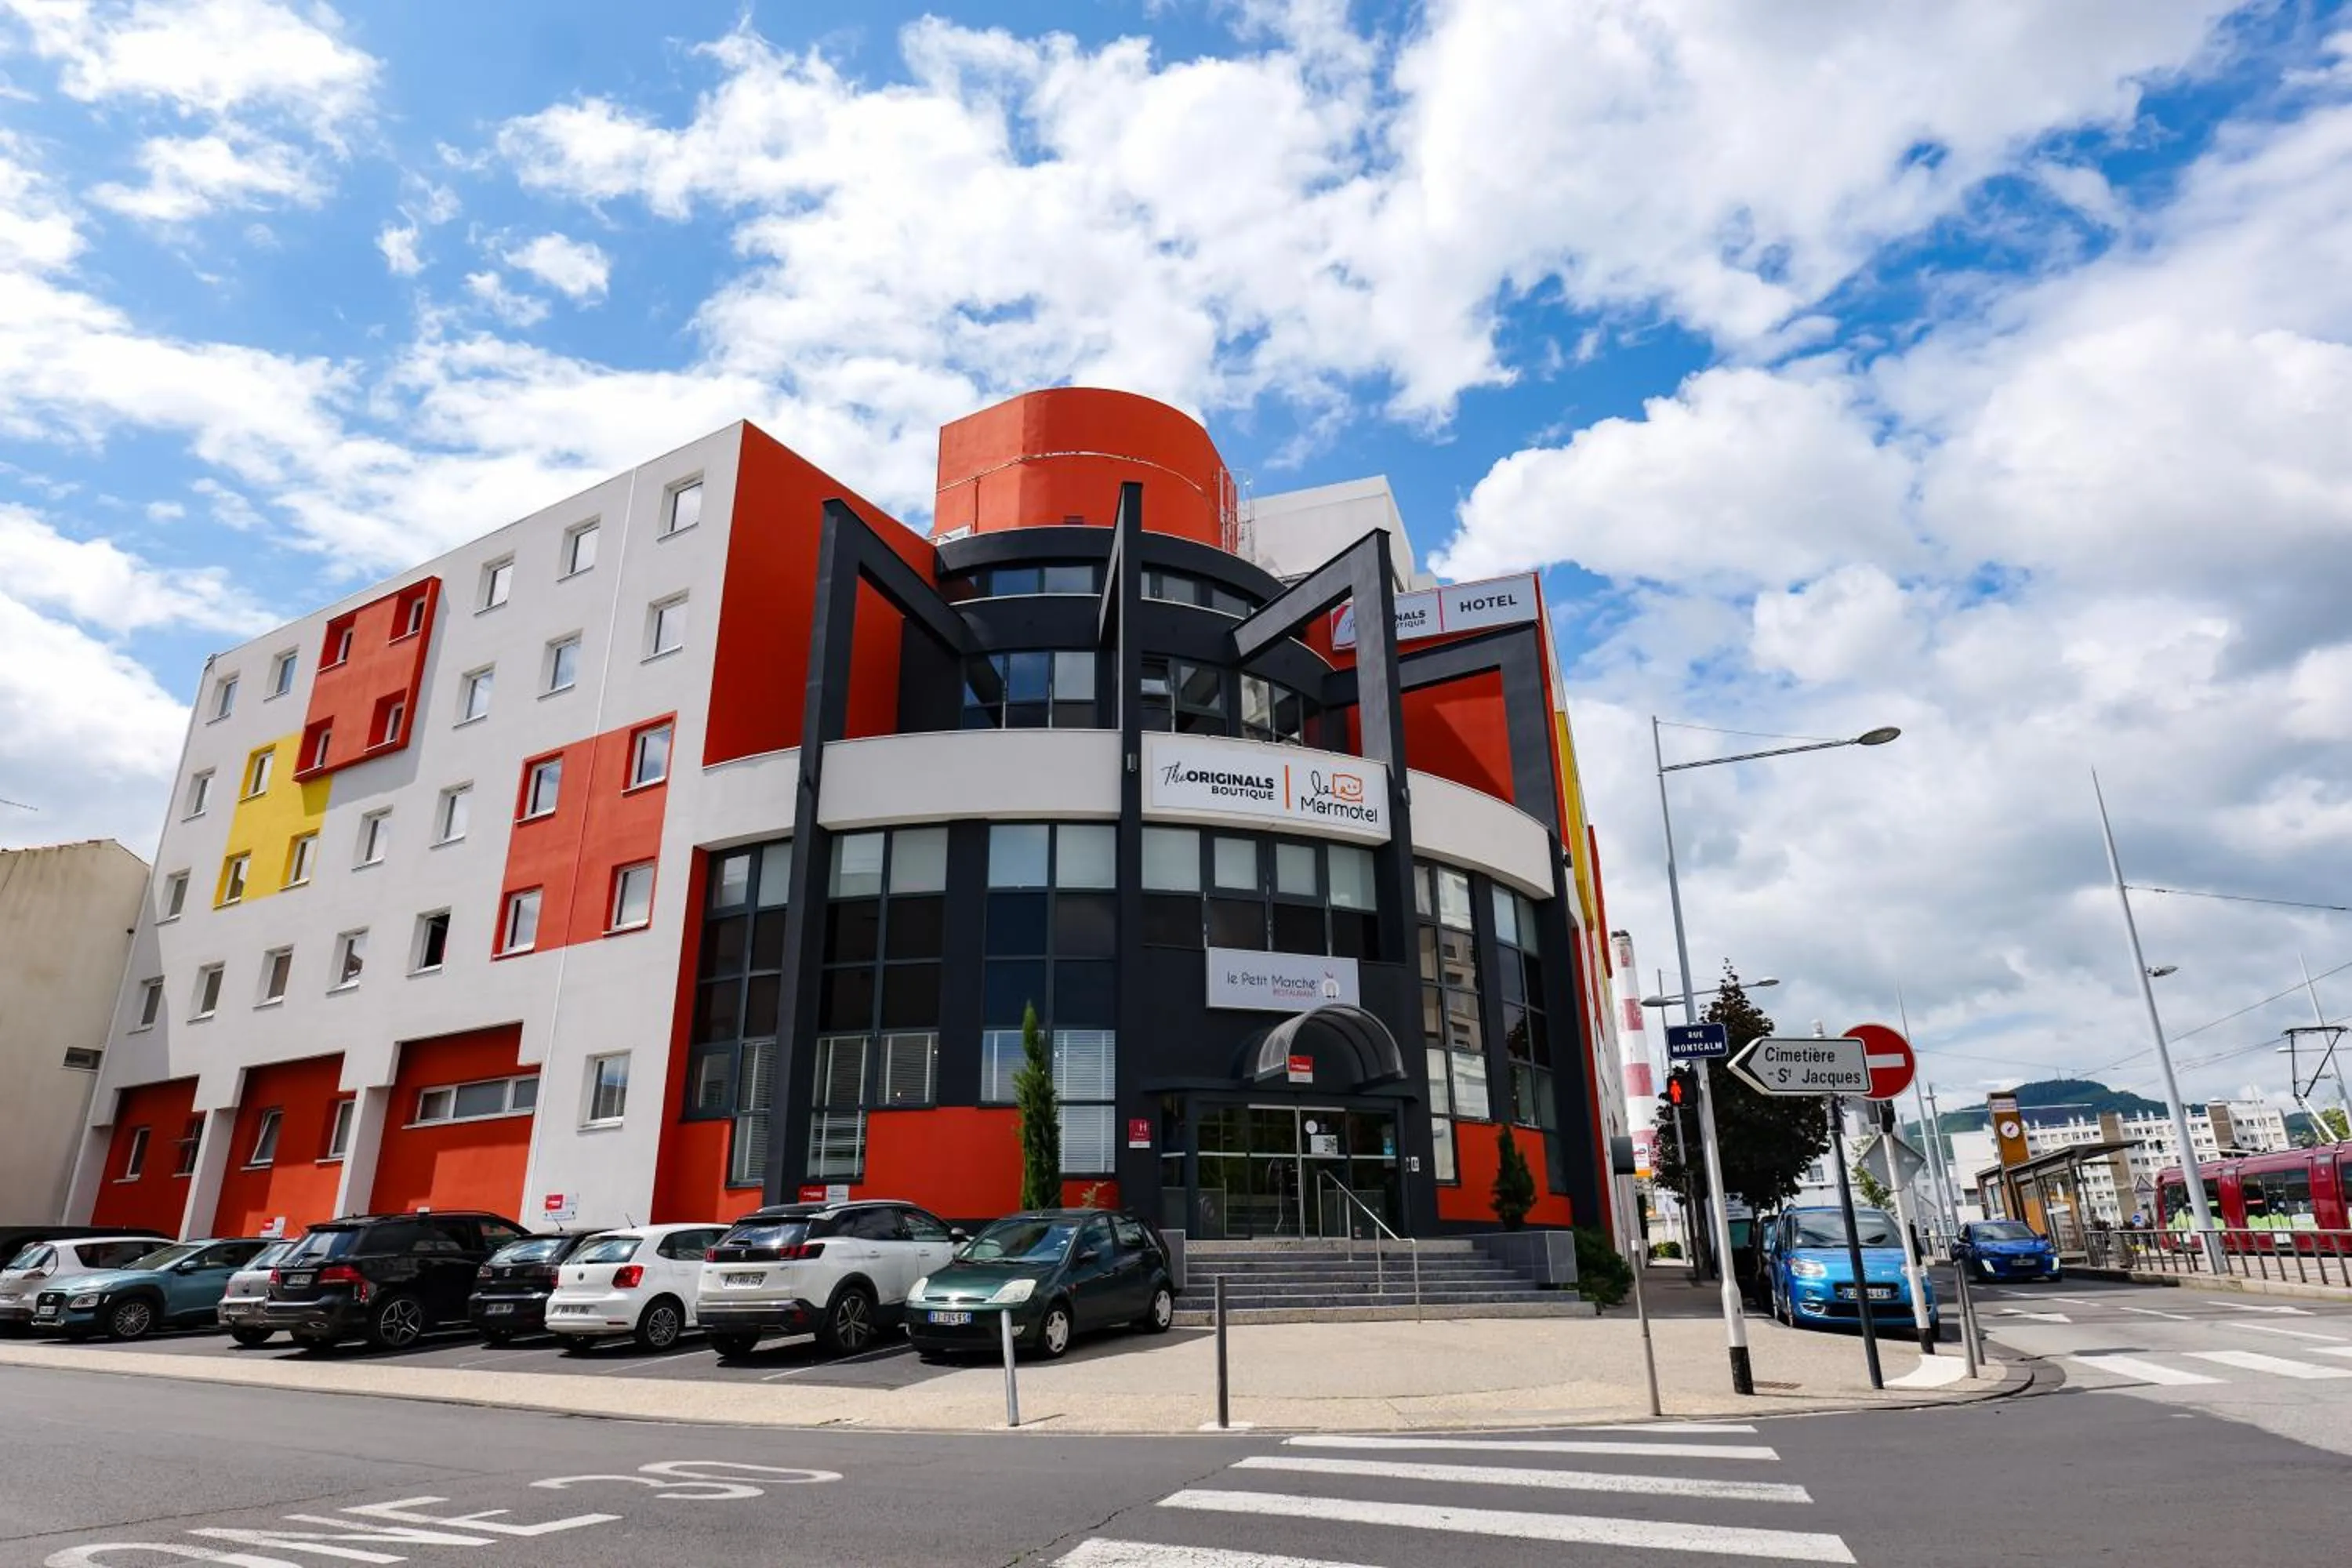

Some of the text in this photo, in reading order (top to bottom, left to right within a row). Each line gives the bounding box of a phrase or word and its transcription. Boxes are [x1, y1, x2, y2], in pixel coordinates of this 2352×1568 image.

[1459, 593, 1518, 612] HOTEL
[1186, 771, 1274, 789] ORIGINALS
[1310, 771, 1333, 797] le
[1211, 785, 1274, 800] BOUTIQUE
[1301, 796, 1378, 822] Marmotel
[1227, 970, 1238, 985] le
[1241, 972, 1267, 985] Petit
[1688, 1030, 1704, 1039] RUE
[1672, 1041, 1723, 1054] MONTCALM
[1765, 1047, 1835, 1063] Cimetière
[1802, 1068, 1861, 1087] Jacques
